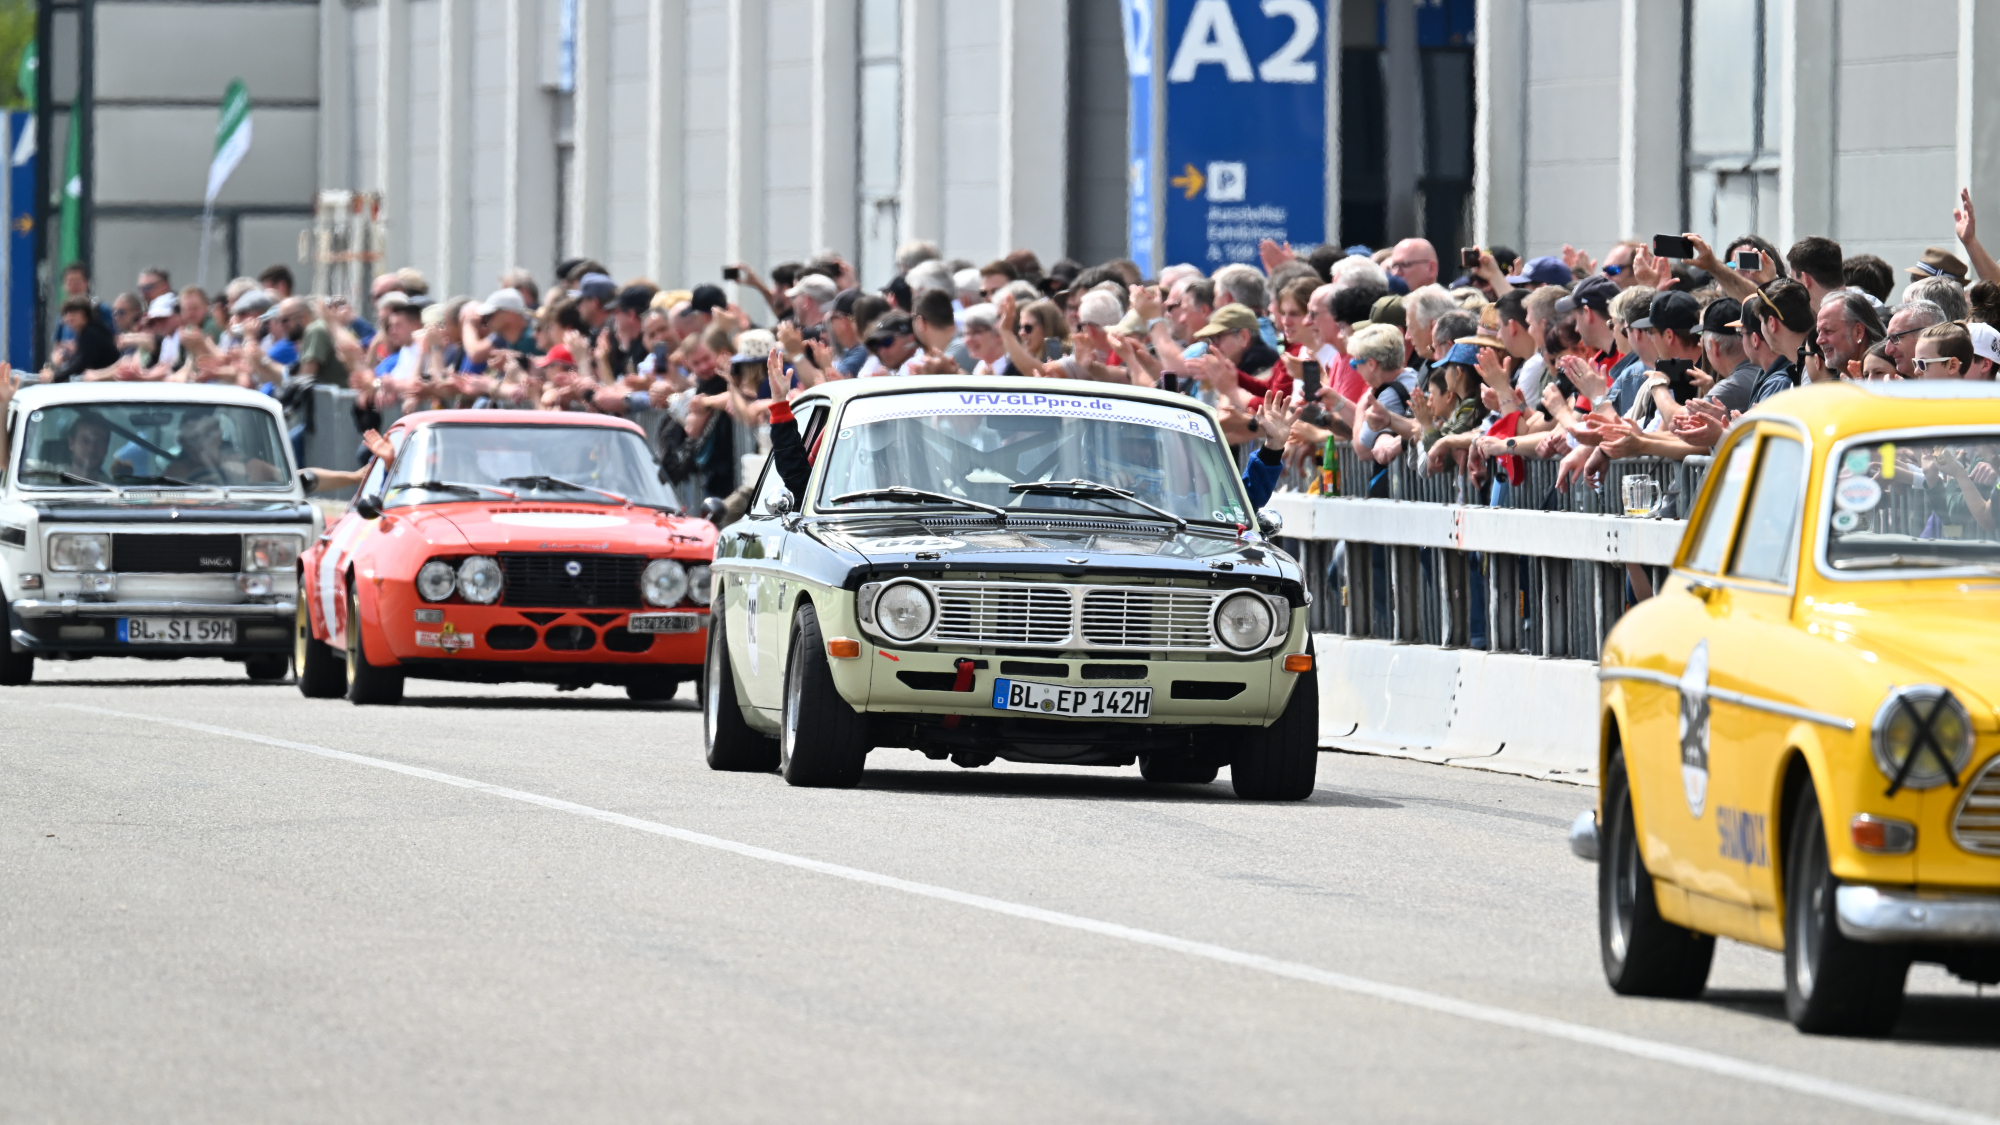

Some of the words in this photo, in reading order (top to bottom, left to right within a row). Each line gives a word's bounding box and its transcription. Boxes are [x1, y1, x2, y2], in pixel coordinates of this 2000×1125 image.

[1167, 0, 1319, 84] A2
[959, 394, 1112, 410] VFV-GLPpro.de
[1189, 421, 1200, 431] B
[1878, 443, 1896, 479] 1
[199, 556, 233, 567] SIMCA
[129, 620, 155, 639] BL
[168, 620, 191, 641] SI
[197, 620, 233, 640] 59H
[1009, 684, 1038, 709] BL
[1056, 690, 1087, 713] EP
[1092, 691, 1150, 714] 142H
